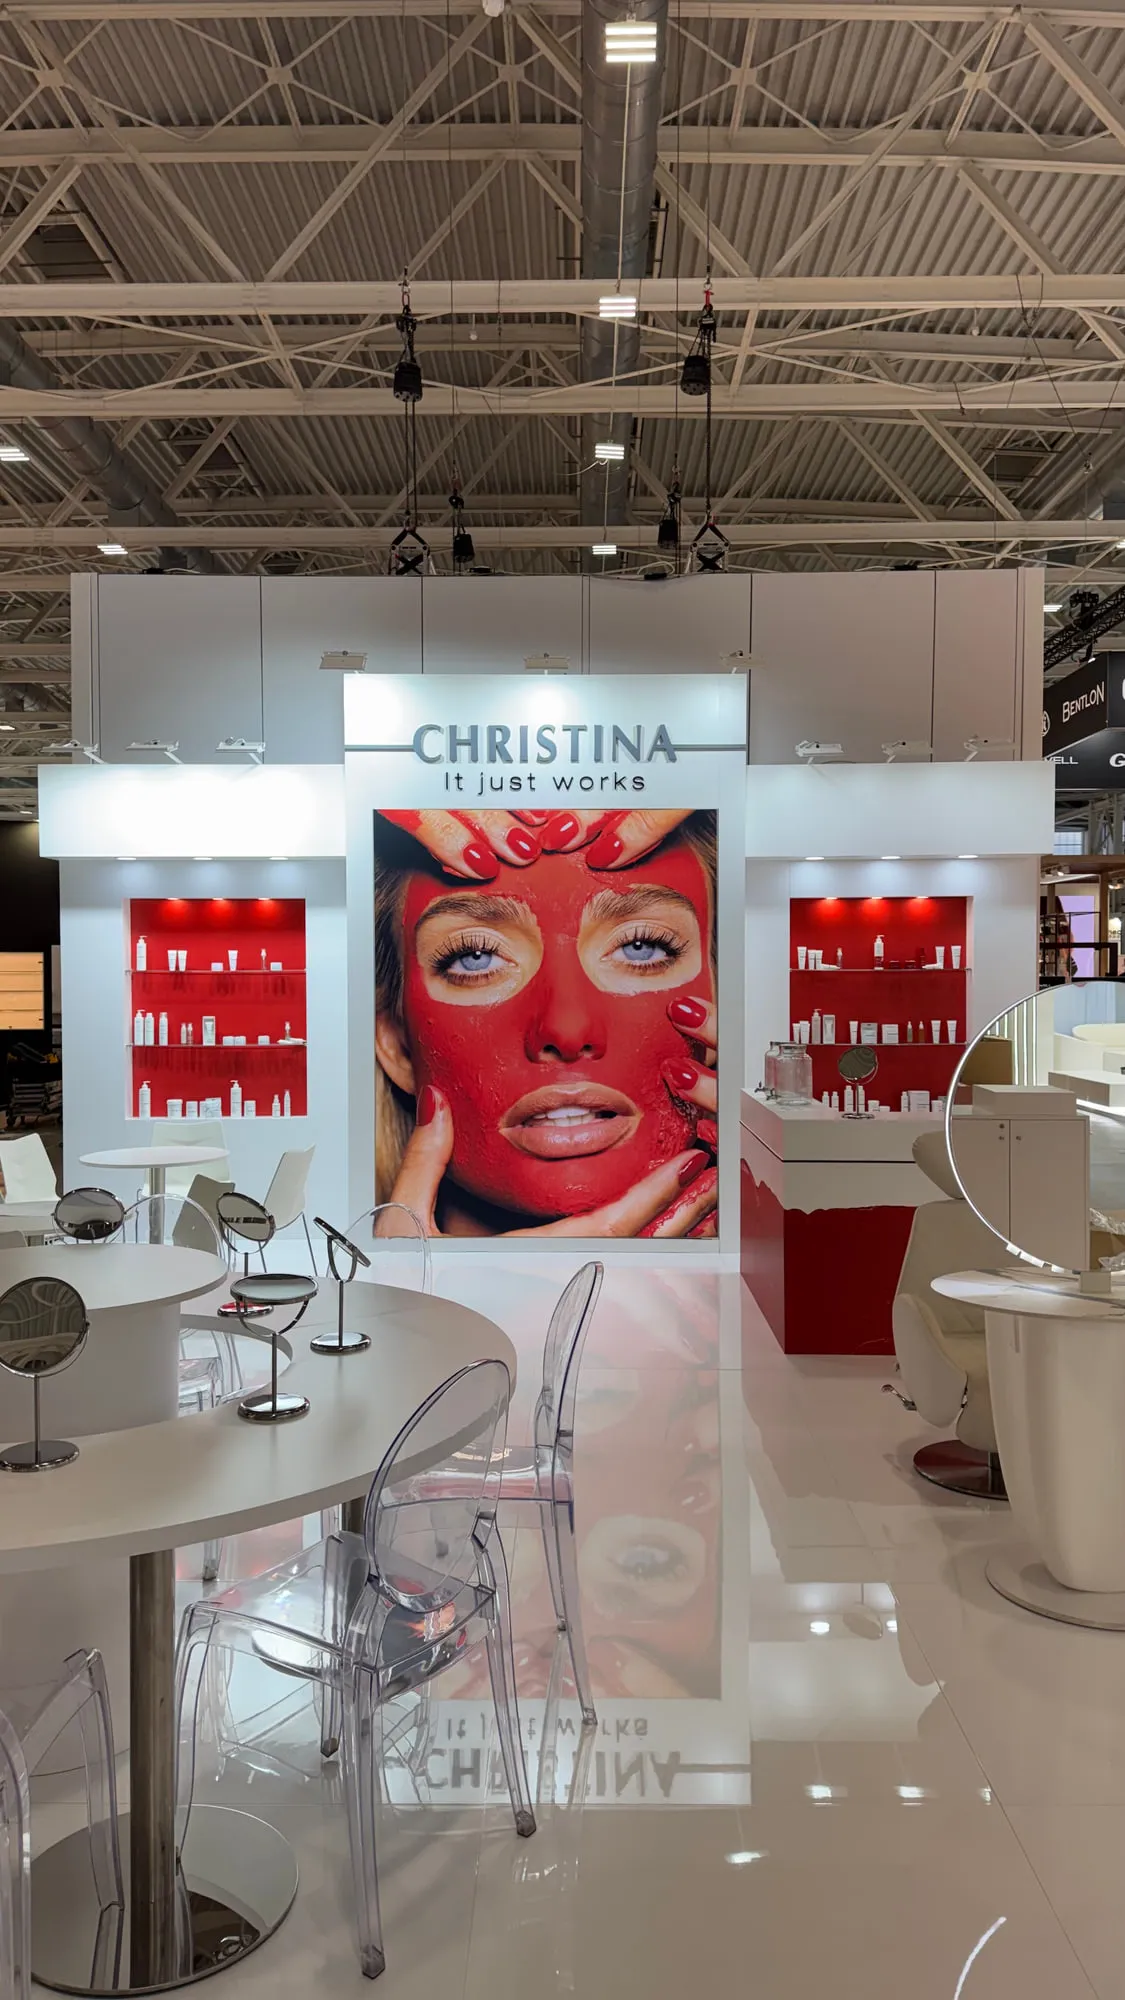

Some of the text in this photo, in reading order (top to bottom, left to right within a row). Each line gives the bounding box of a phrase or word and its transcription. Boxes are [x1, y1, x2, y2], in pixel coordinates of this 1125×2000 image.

[1063, 681, 1104, 723] BENTLON
[413, 724, 677, 764] CHRISTINA
[445, 772, 645, 796] It just works
